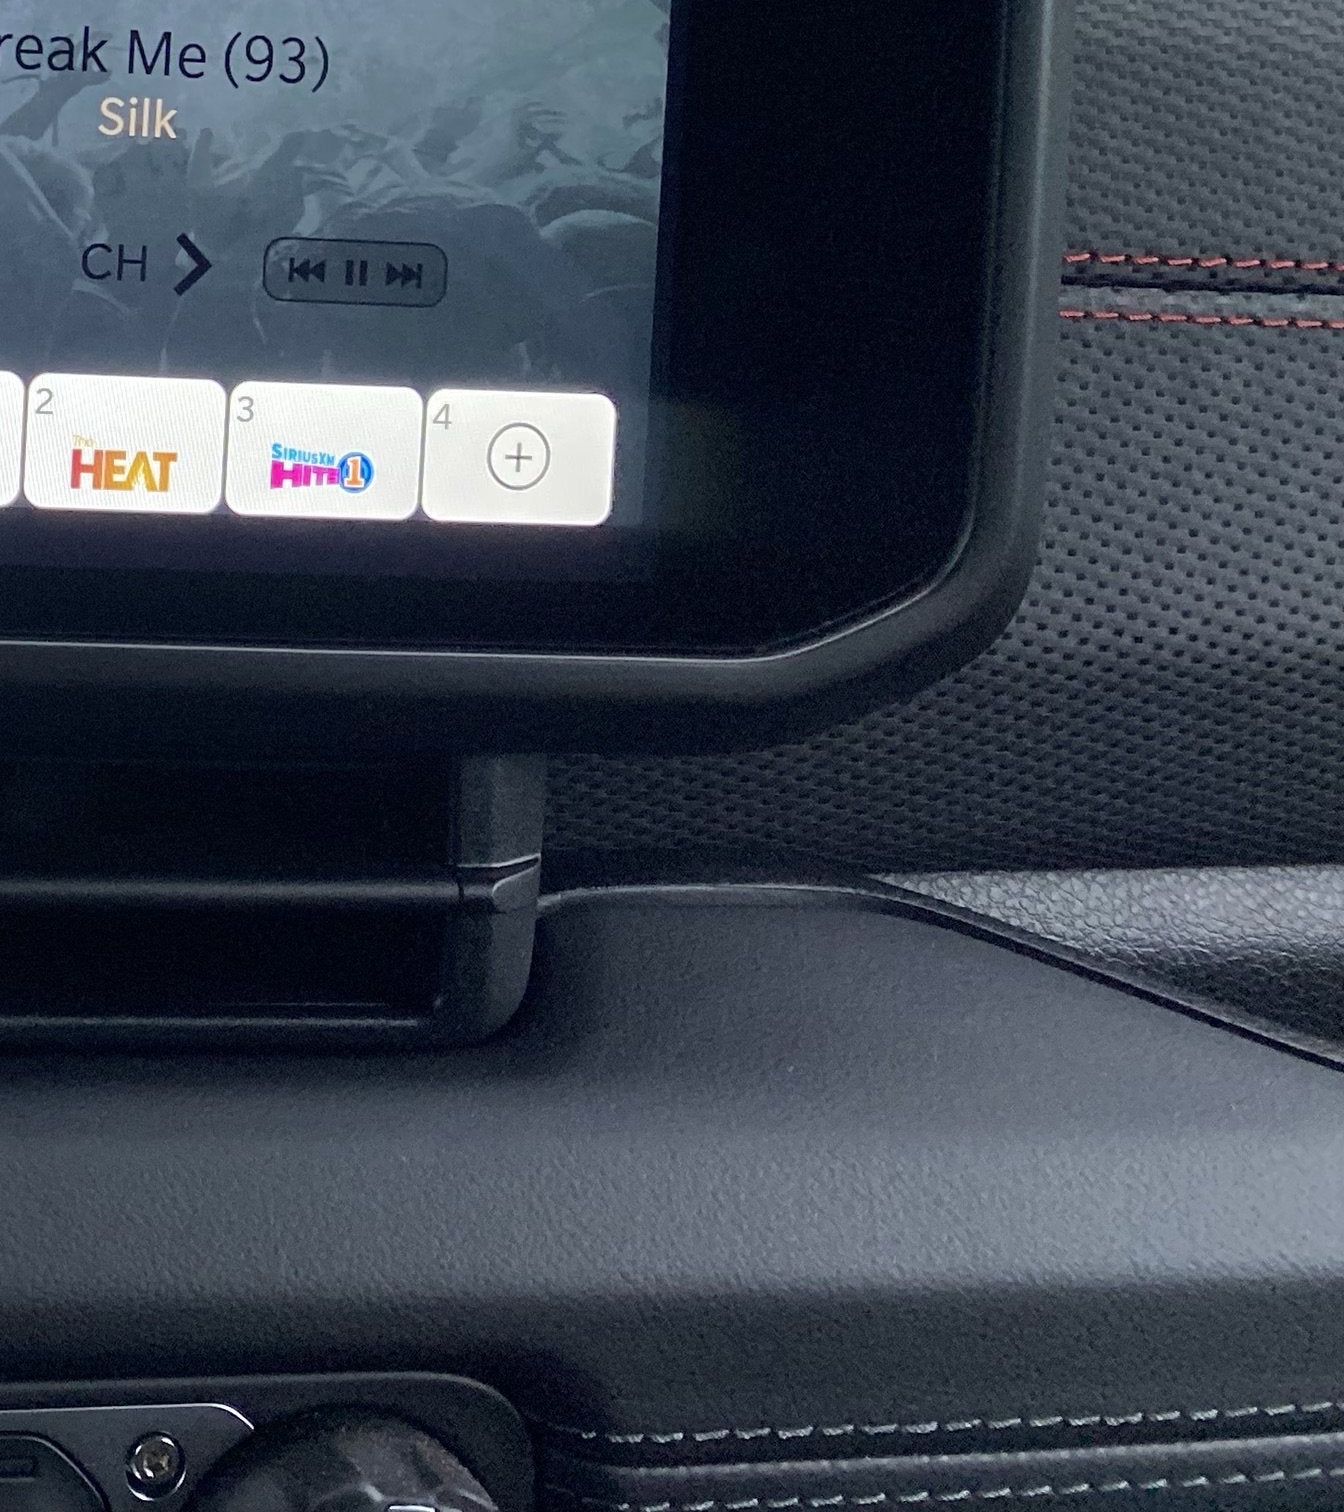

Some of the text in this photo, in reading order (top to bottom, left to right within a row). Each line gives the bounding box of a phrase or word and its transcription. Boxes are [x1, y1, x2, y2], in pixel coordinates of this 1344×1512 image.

[127, 28, 207, 79] Me
[223, 31, 330, 92] (93)
[98, 96, 178, 140] Silk
[80, 243, 149, 282] CH
[35, 387, 55, 415] 2
[236, 396, 255, 423] 3
[431, 403, 453, 430] 4
[70, 448, 178, 492] HEAT
